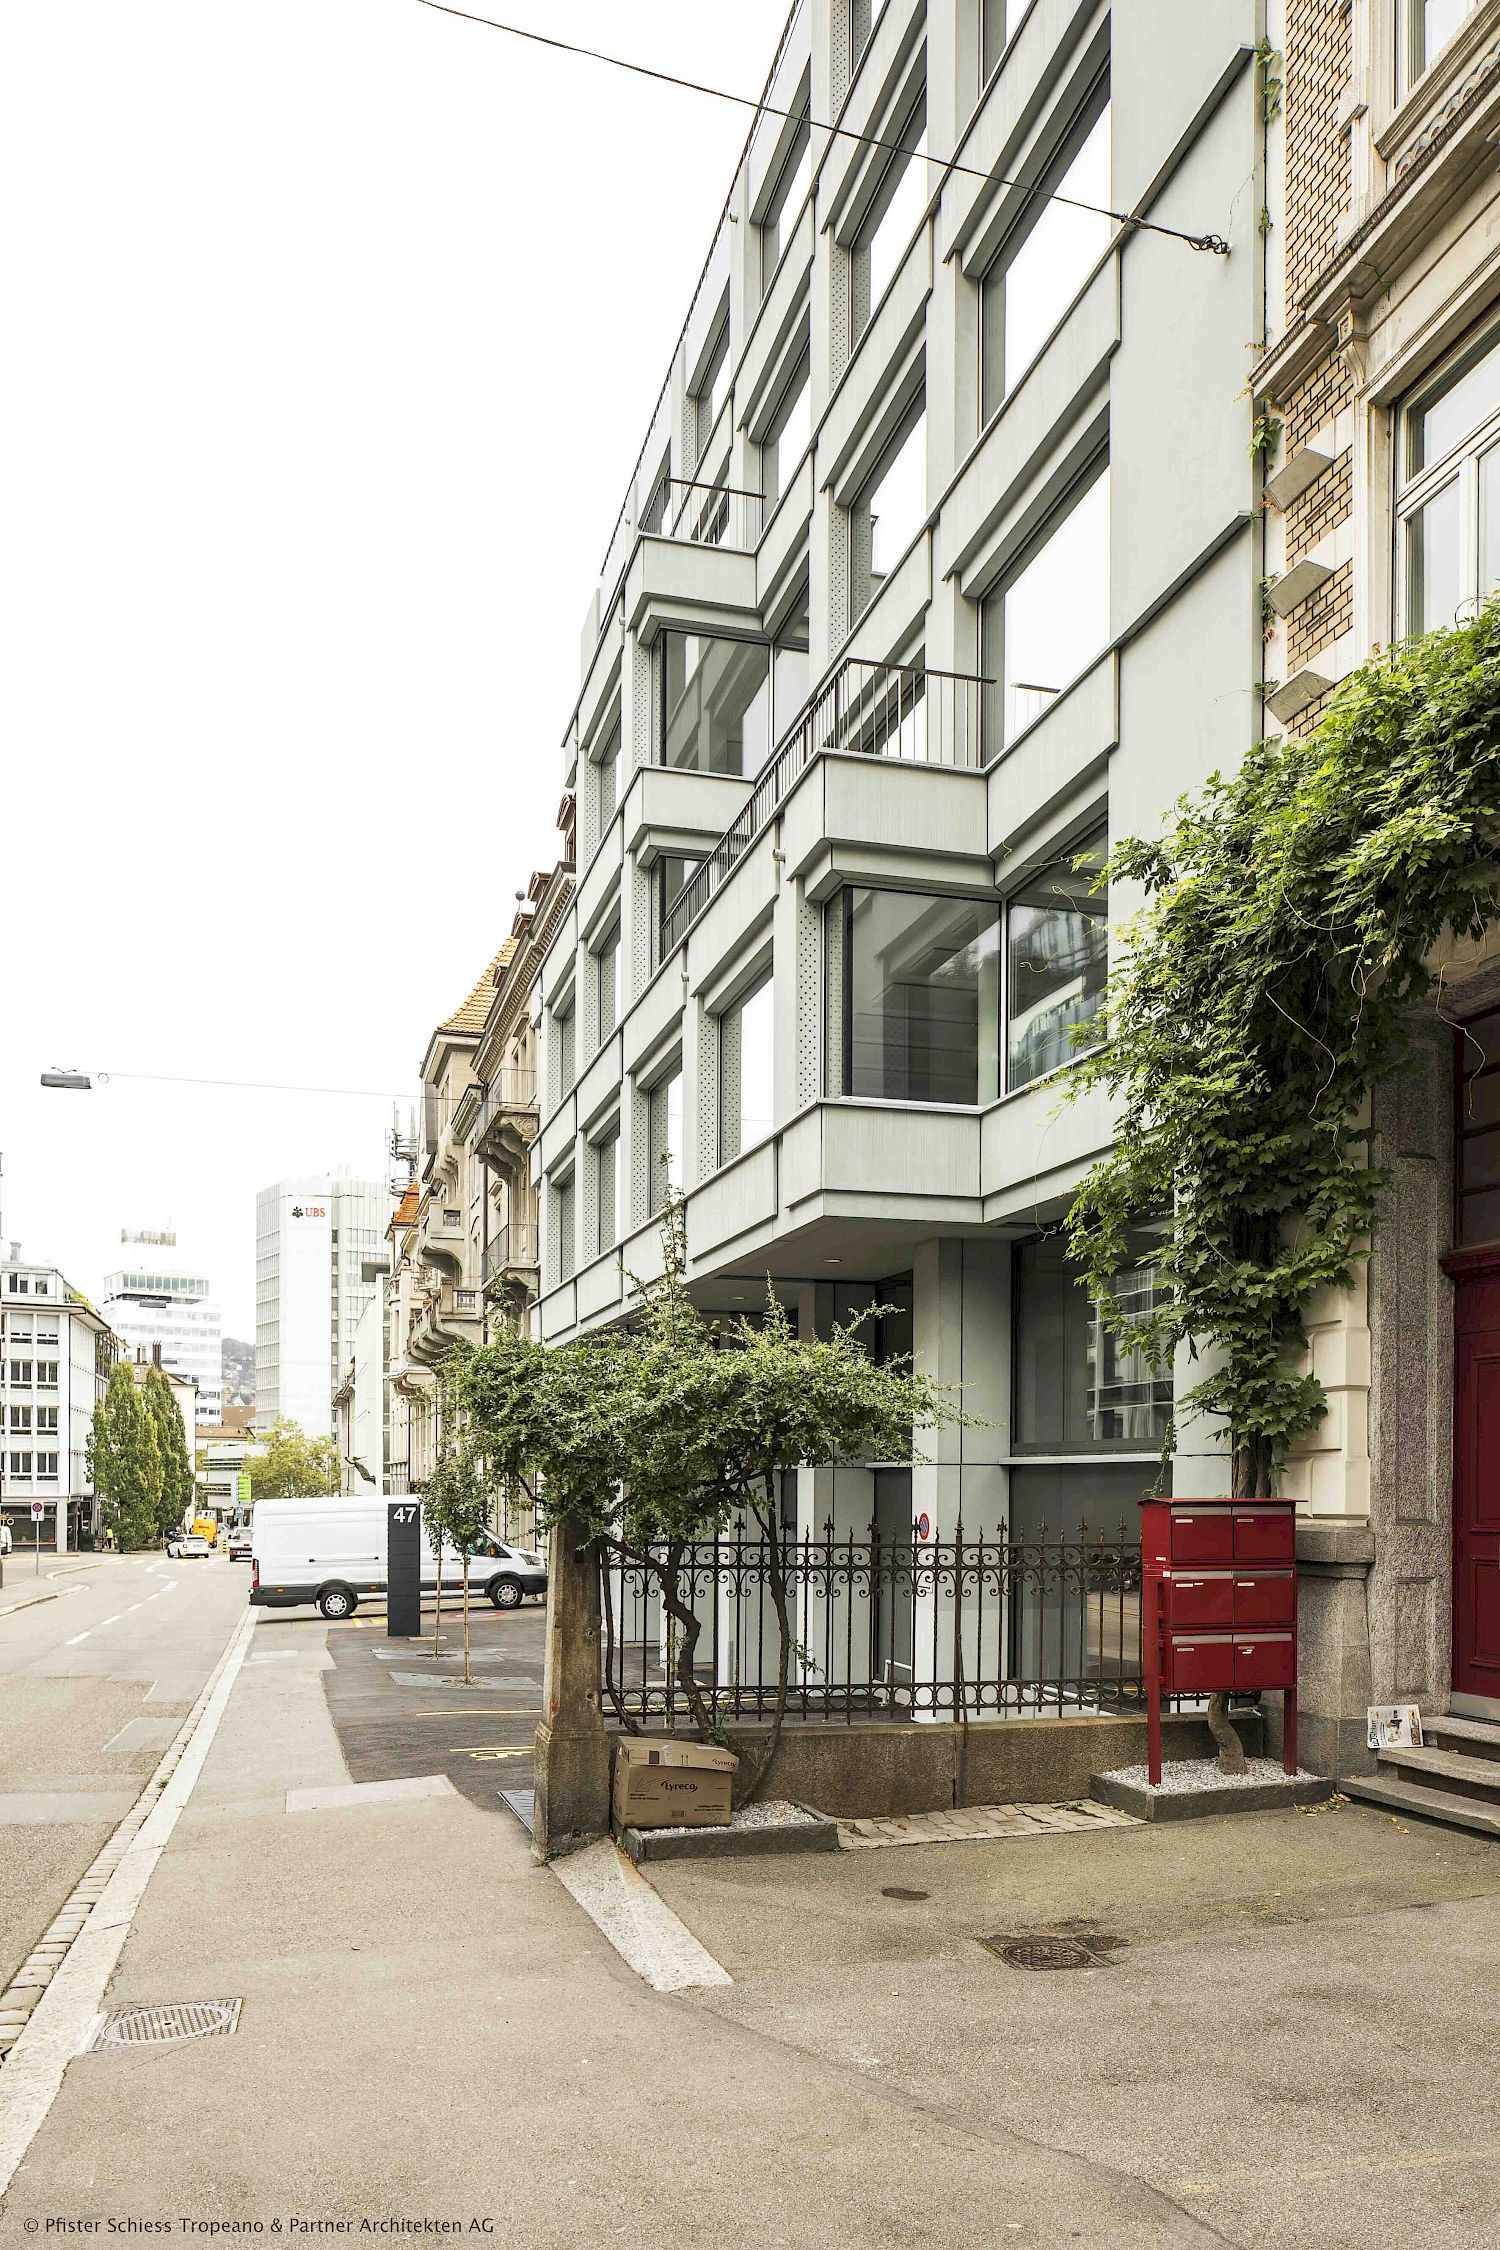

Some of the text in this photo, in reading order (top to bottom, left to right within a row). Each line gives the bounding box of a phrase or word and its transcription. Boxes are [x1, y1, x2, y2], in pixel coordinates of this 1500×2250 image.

[305, 1207, 326, 1217] UBS
[393, 1506, 417, 1524] 47
[664, 1781, 697, 1792] Lyreco
